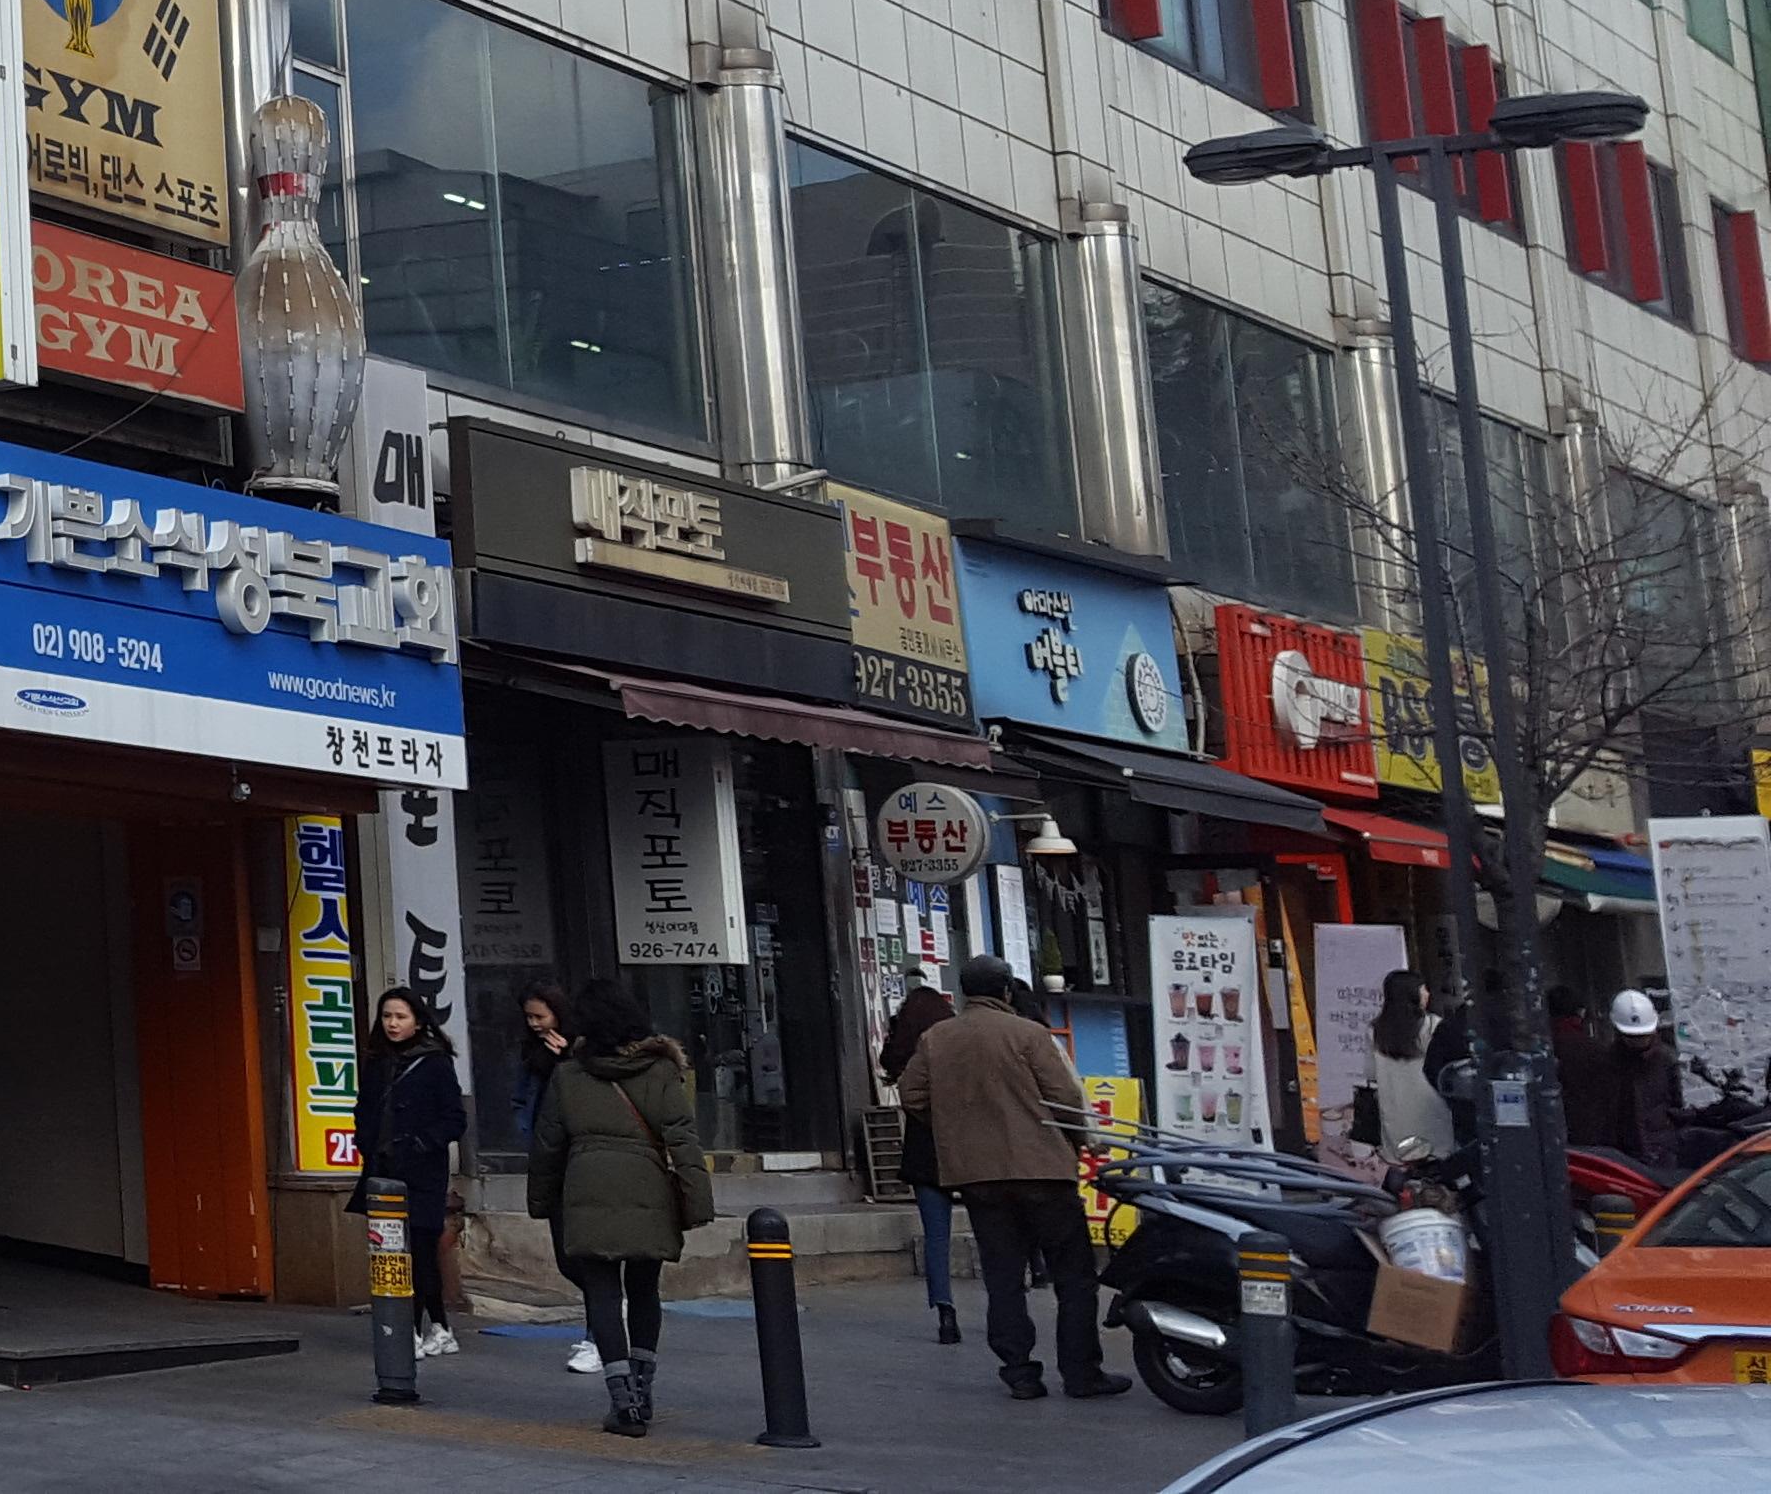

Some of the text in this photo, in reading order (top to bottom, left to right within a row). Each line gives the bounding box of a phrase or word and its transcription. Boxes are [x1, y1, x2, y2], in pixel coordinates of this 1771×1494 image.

[154, 172, 220, 228] 스포츠
[36, 305, 182, 378] GYM
[851, 509, 954, 625] 부동산
[268, 669, 397, 709] www.goodnews.kr
[1025, 627, 1084, 703] 버블티
[325, 726, 444, 779] 창천프라자
[899, 792, 946, 813] 예스
[633, 749, 692, 913] 매직포토
[887, 820, 967, 854] 부동산
[629, 942, 719, 958] 926-7474
[1172, 951, 1235, 974] 음료타임
